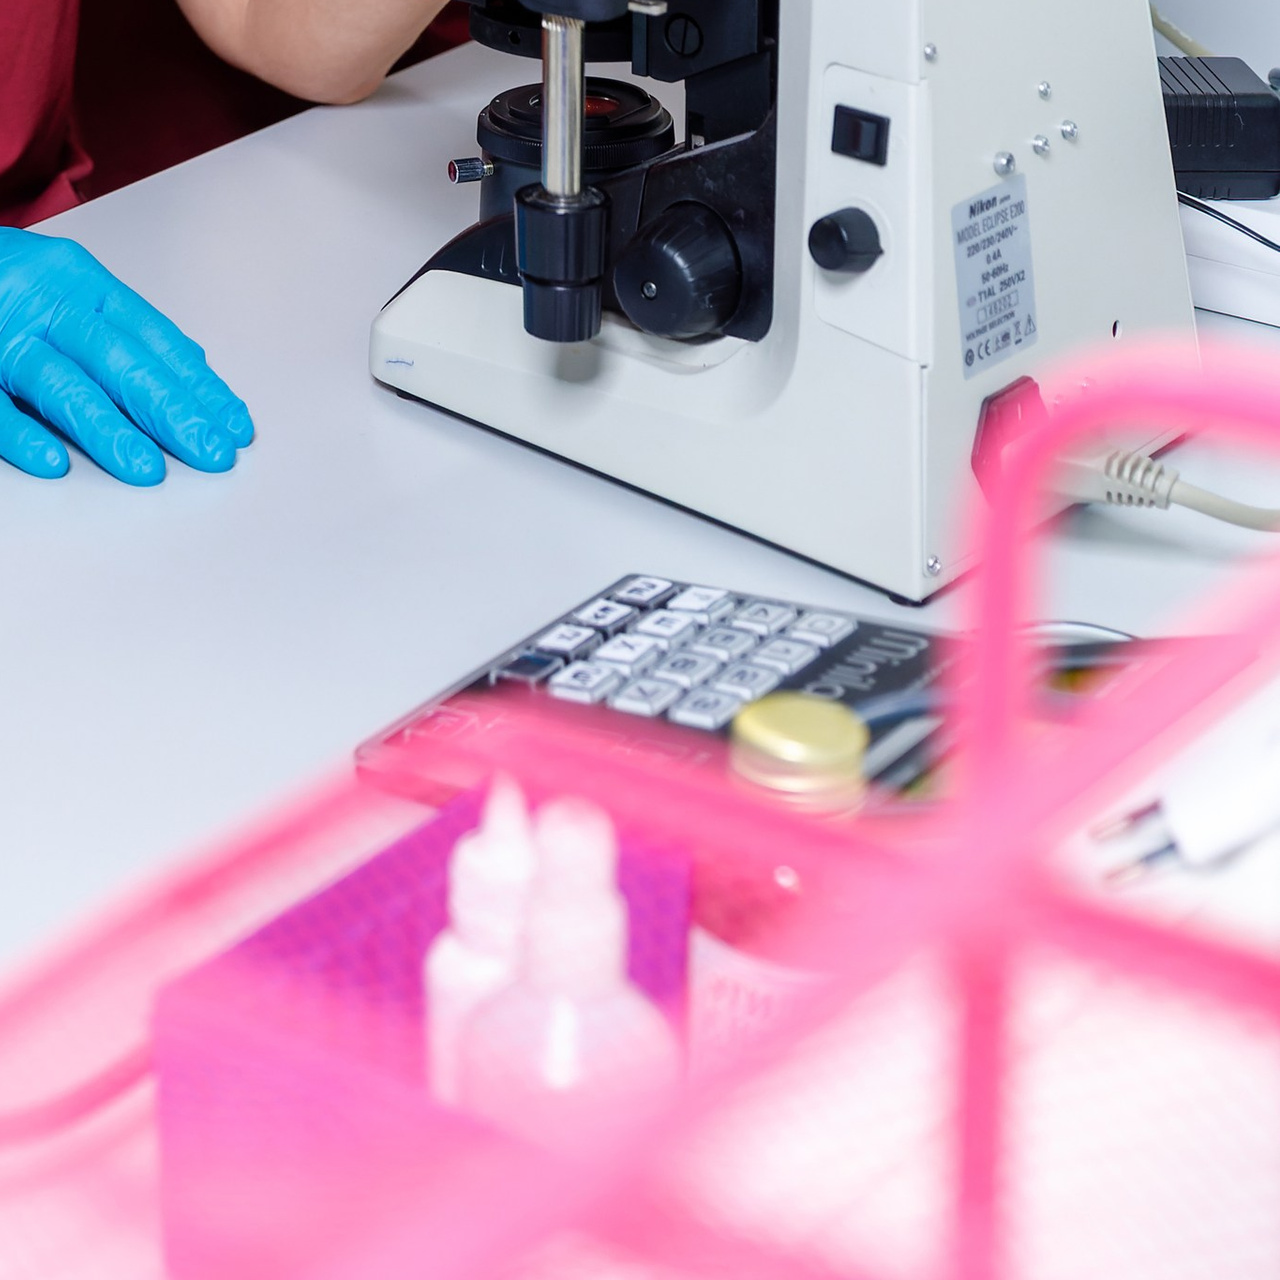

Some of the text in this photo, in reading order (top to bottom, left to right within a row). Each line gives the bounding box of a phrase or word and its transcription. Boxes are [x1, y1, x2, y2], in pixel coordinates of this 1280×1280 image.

[969, 196, 997, 219] Nikon
[957, 222, 981, 245] MODEL
[982, 206, 1010, 233] ECLIPSE
